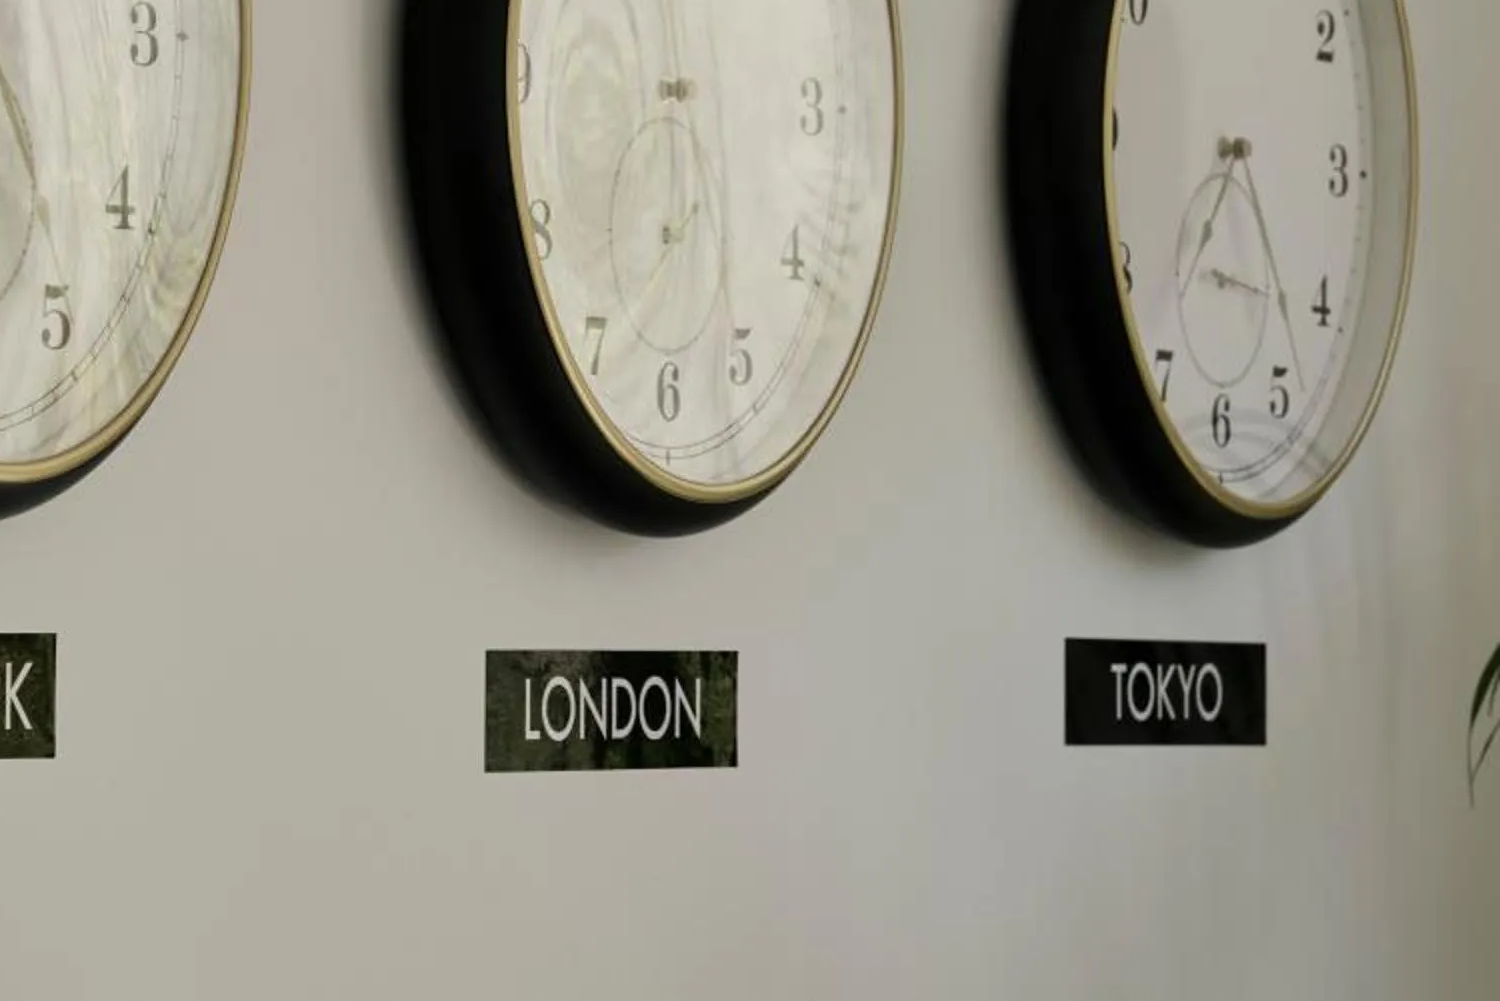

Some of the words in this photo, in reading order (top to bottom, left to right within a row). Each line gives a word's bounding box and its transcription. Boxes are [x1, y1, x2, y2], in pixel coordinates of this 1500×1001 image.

[130, 2, 158, 66] 3
[1315, 10, 1335, 63] 2
[800, 77, 823, 136] 3
[106, 165, 136, 230] 4
[1329, 144, 1348, 197] 3
[530, 199, 553, 260] 8
[781, 225, 805, 281] 4
[41, 284, 70, 350] 5
[1311, 275, 1331, 327] 4
[585, 316, 607, 376] 7
[730, 328, 752, 385] 5
[656, 362, 680, 422] 6
[1156, 350, 1173, 402] 7
[1270, 365, 1289, 419] 5
[1212, 394, 1231, 448] 6
[525, 676, 700, 741] LONDON
[1110, 662, 1223, 722] TOKYO
